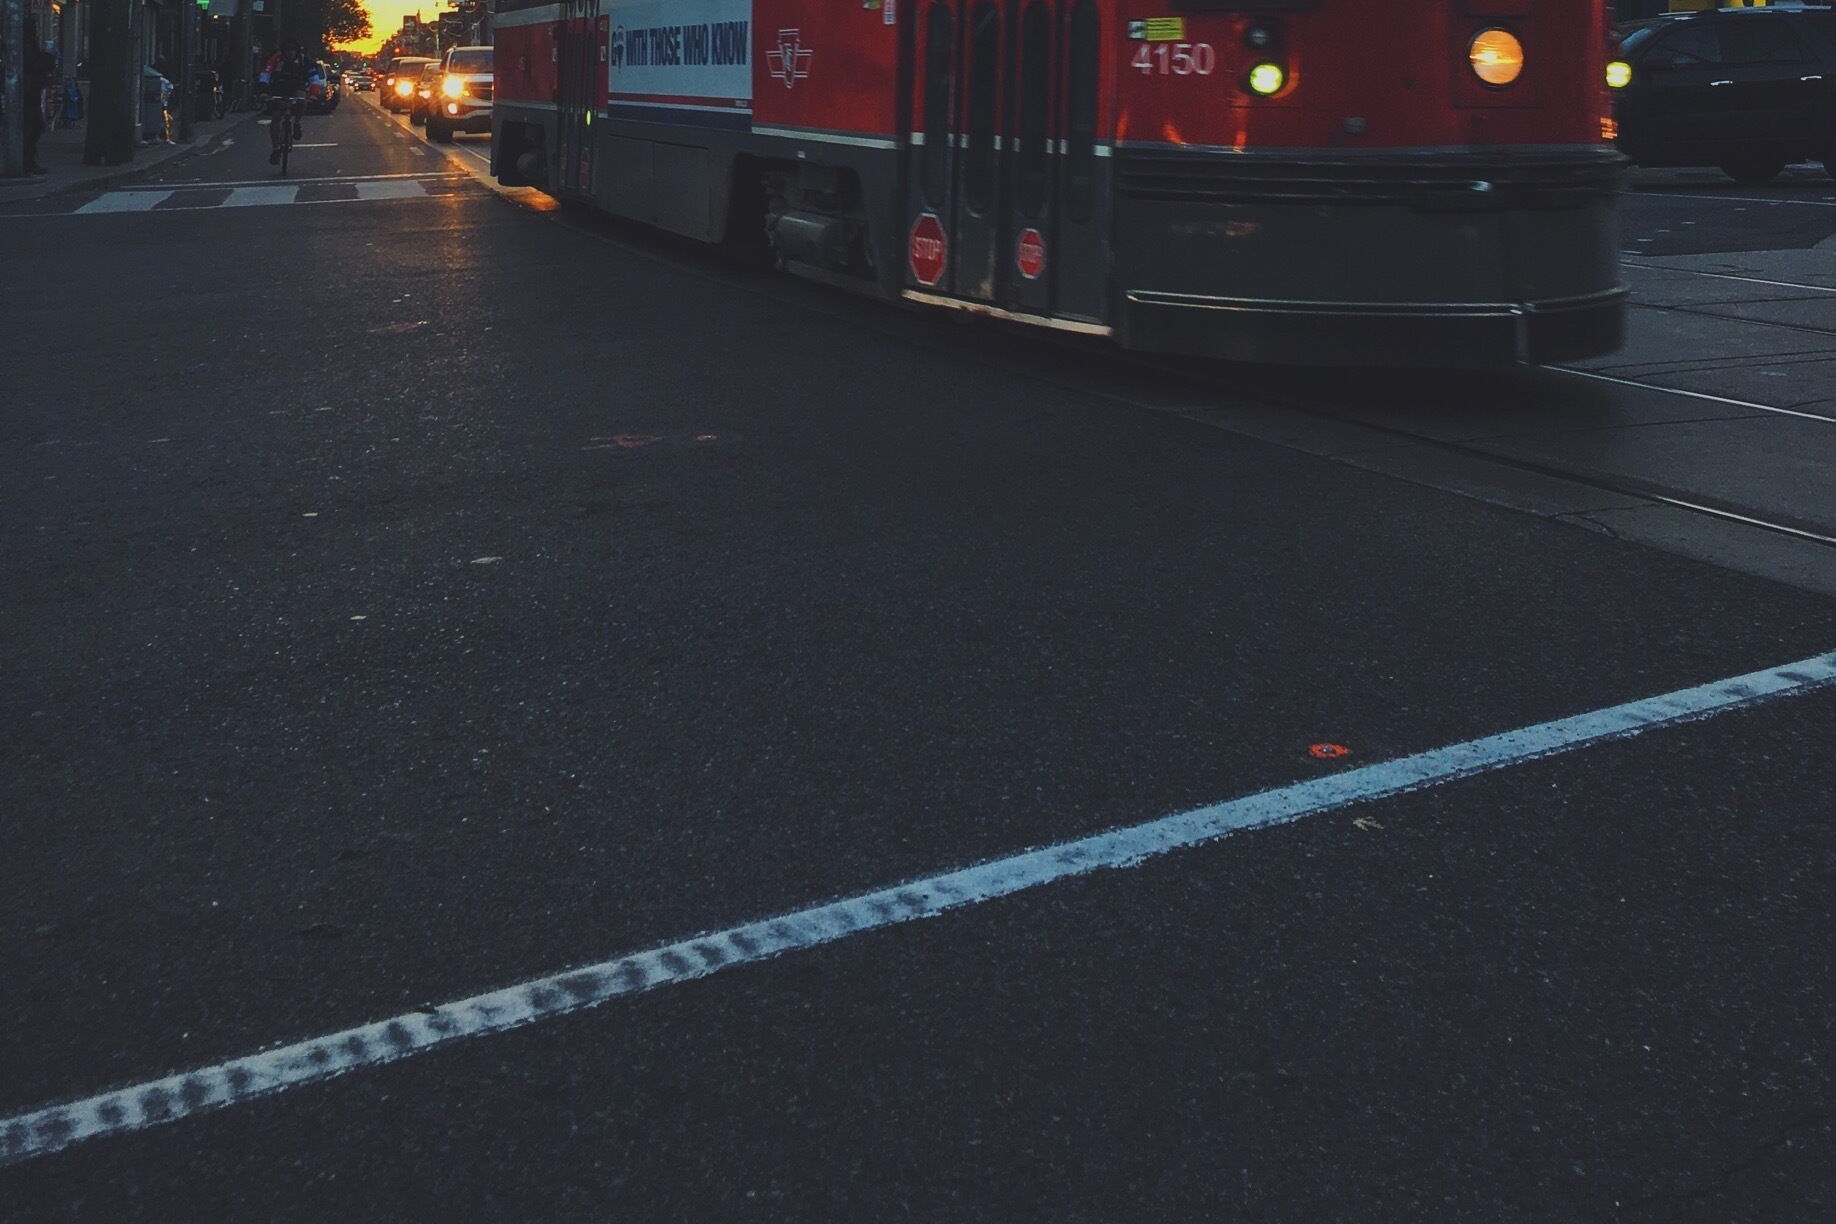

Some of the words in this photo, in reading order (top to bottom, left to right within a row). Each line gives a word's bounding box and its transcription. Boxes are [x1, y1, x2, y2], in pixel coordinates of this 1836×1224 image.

[626, 29, 648, 66] WITH
[649, 26, 681, 66] THOSE
[683, 23, 709, 66] WHO
[711, 21, 748, 66] KNOW
[1131, 42, 1215, 75] 4150
[913, 236, 942, 260] STOP
